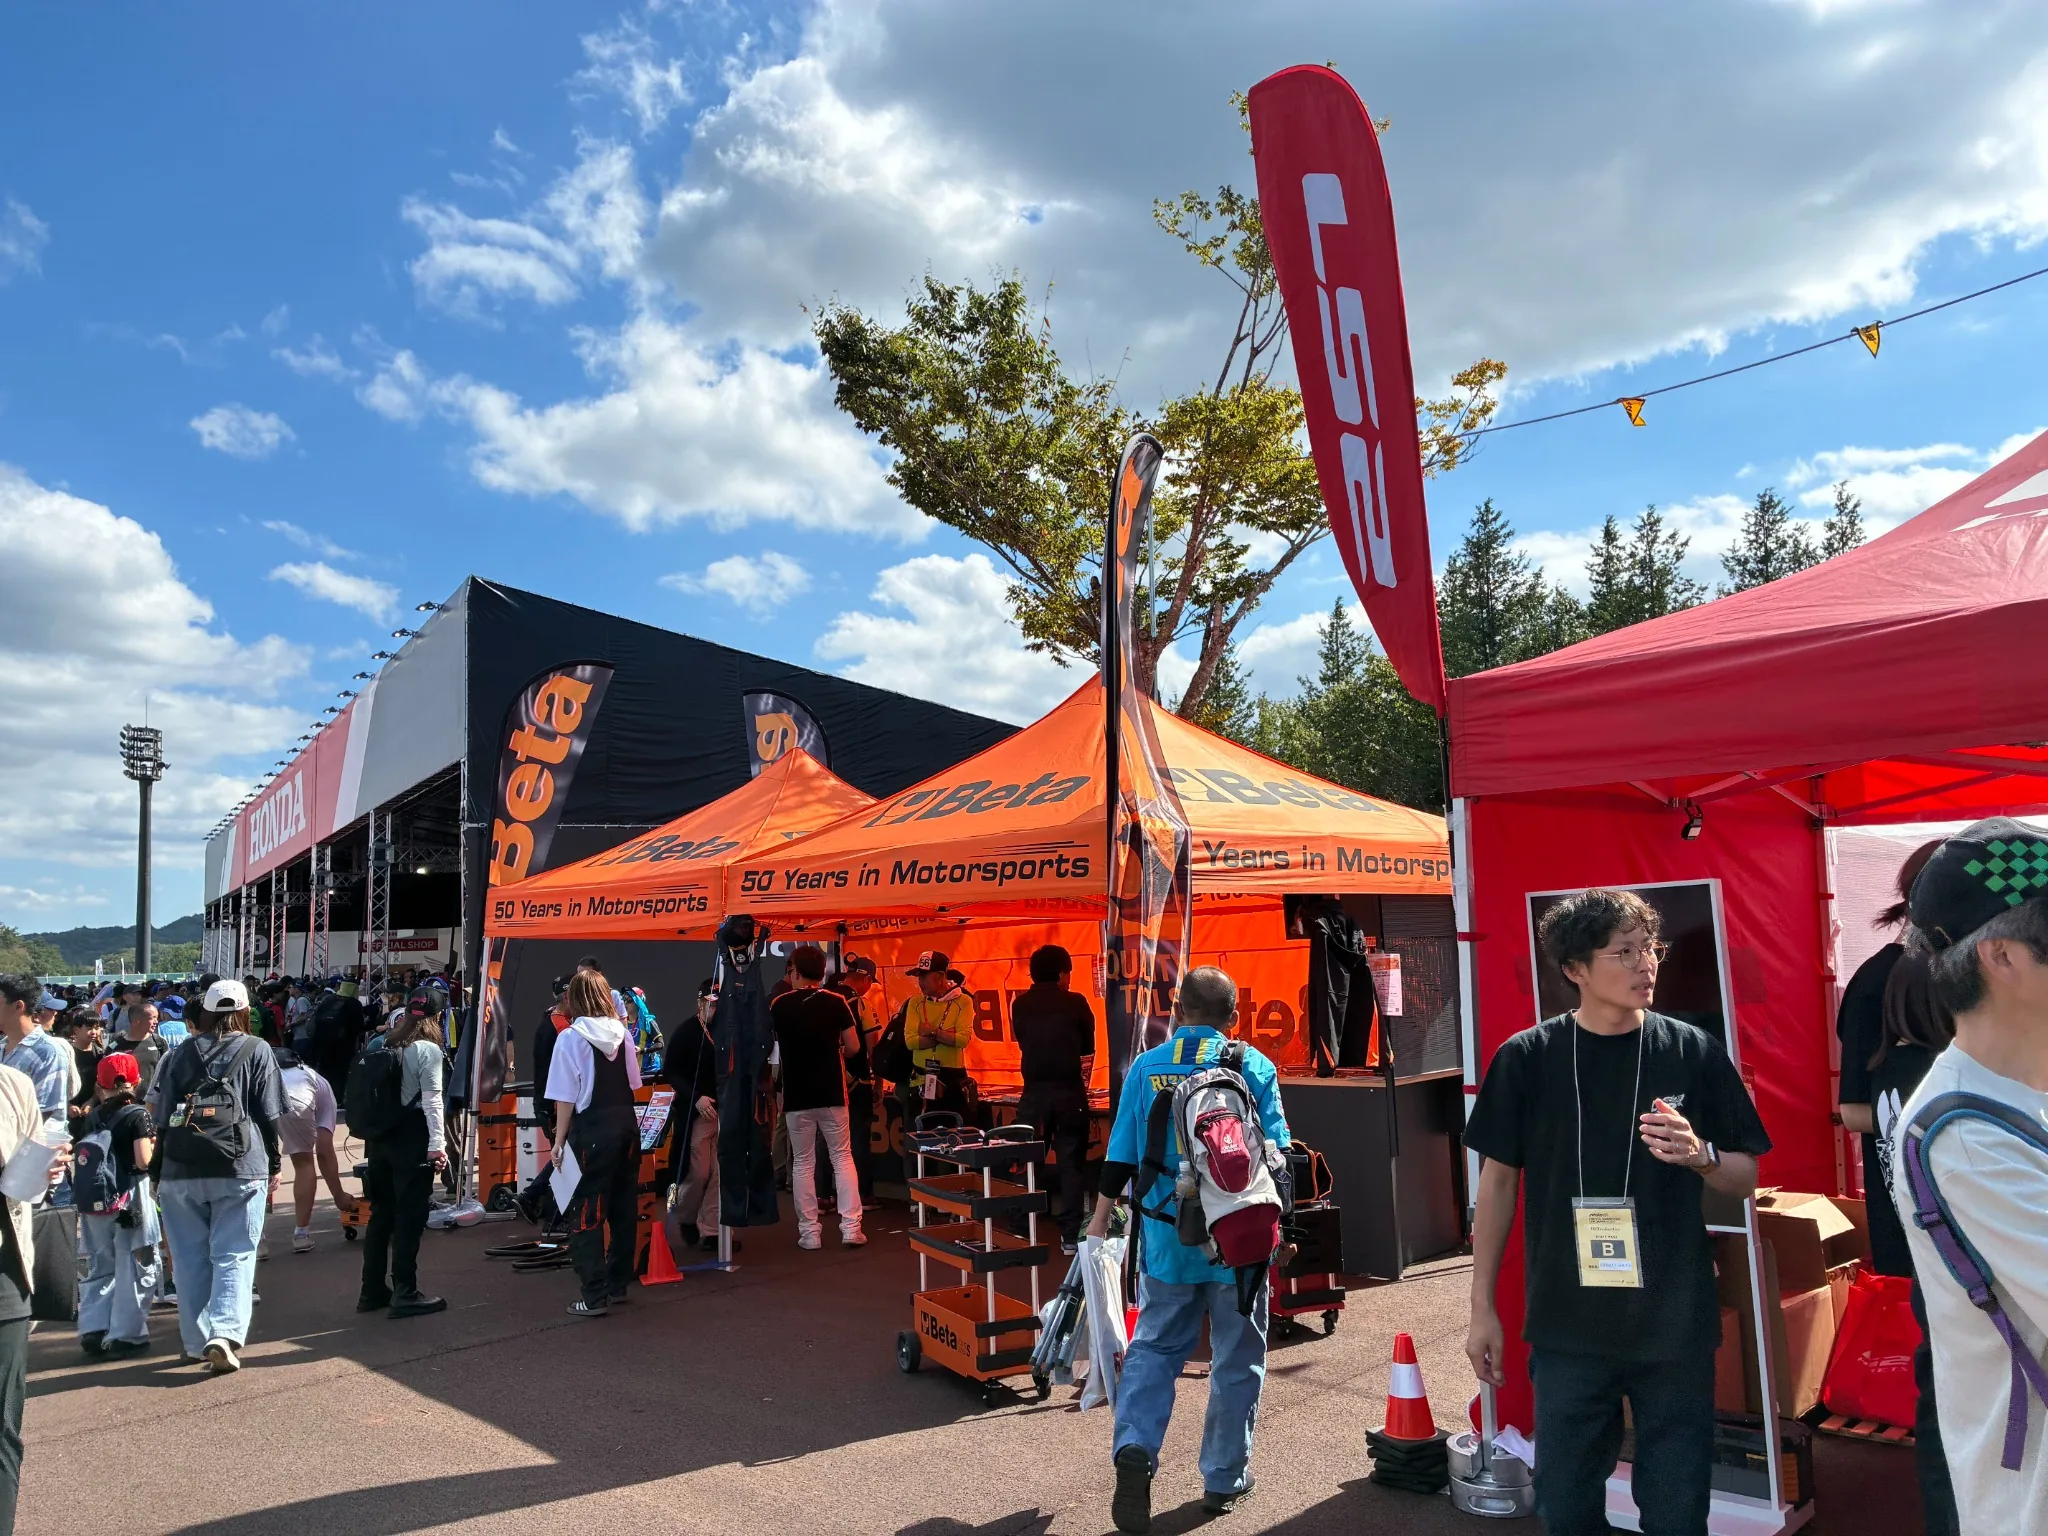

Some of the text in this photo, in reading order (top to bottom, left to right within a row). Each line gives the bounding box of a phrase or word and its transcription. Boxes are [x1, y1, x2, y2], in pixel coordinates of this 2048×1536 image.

[1302, 173, 1397, 589] LS2
[489, 675, 594, 886] Beta
[914, 772, 1092, 822] Beta
[1194, 768, 1387, 812] Beta
[249, 770, 306, 865] HONDA
[616, 834, 740, 864] Beta
[1202, 840, 1449, 881] Years in Motorsp
[741, 853, 1090, 892] 50 Years in Motorsports
[494, 893, 709, 919] 50 Years in Motorsports
[407, 941, 434, 949] SHOP
[920, 958, 930, 968] 56
[1602, 1242, 1615, 1257] B
[930, 1314, 957, 1351] Beta
